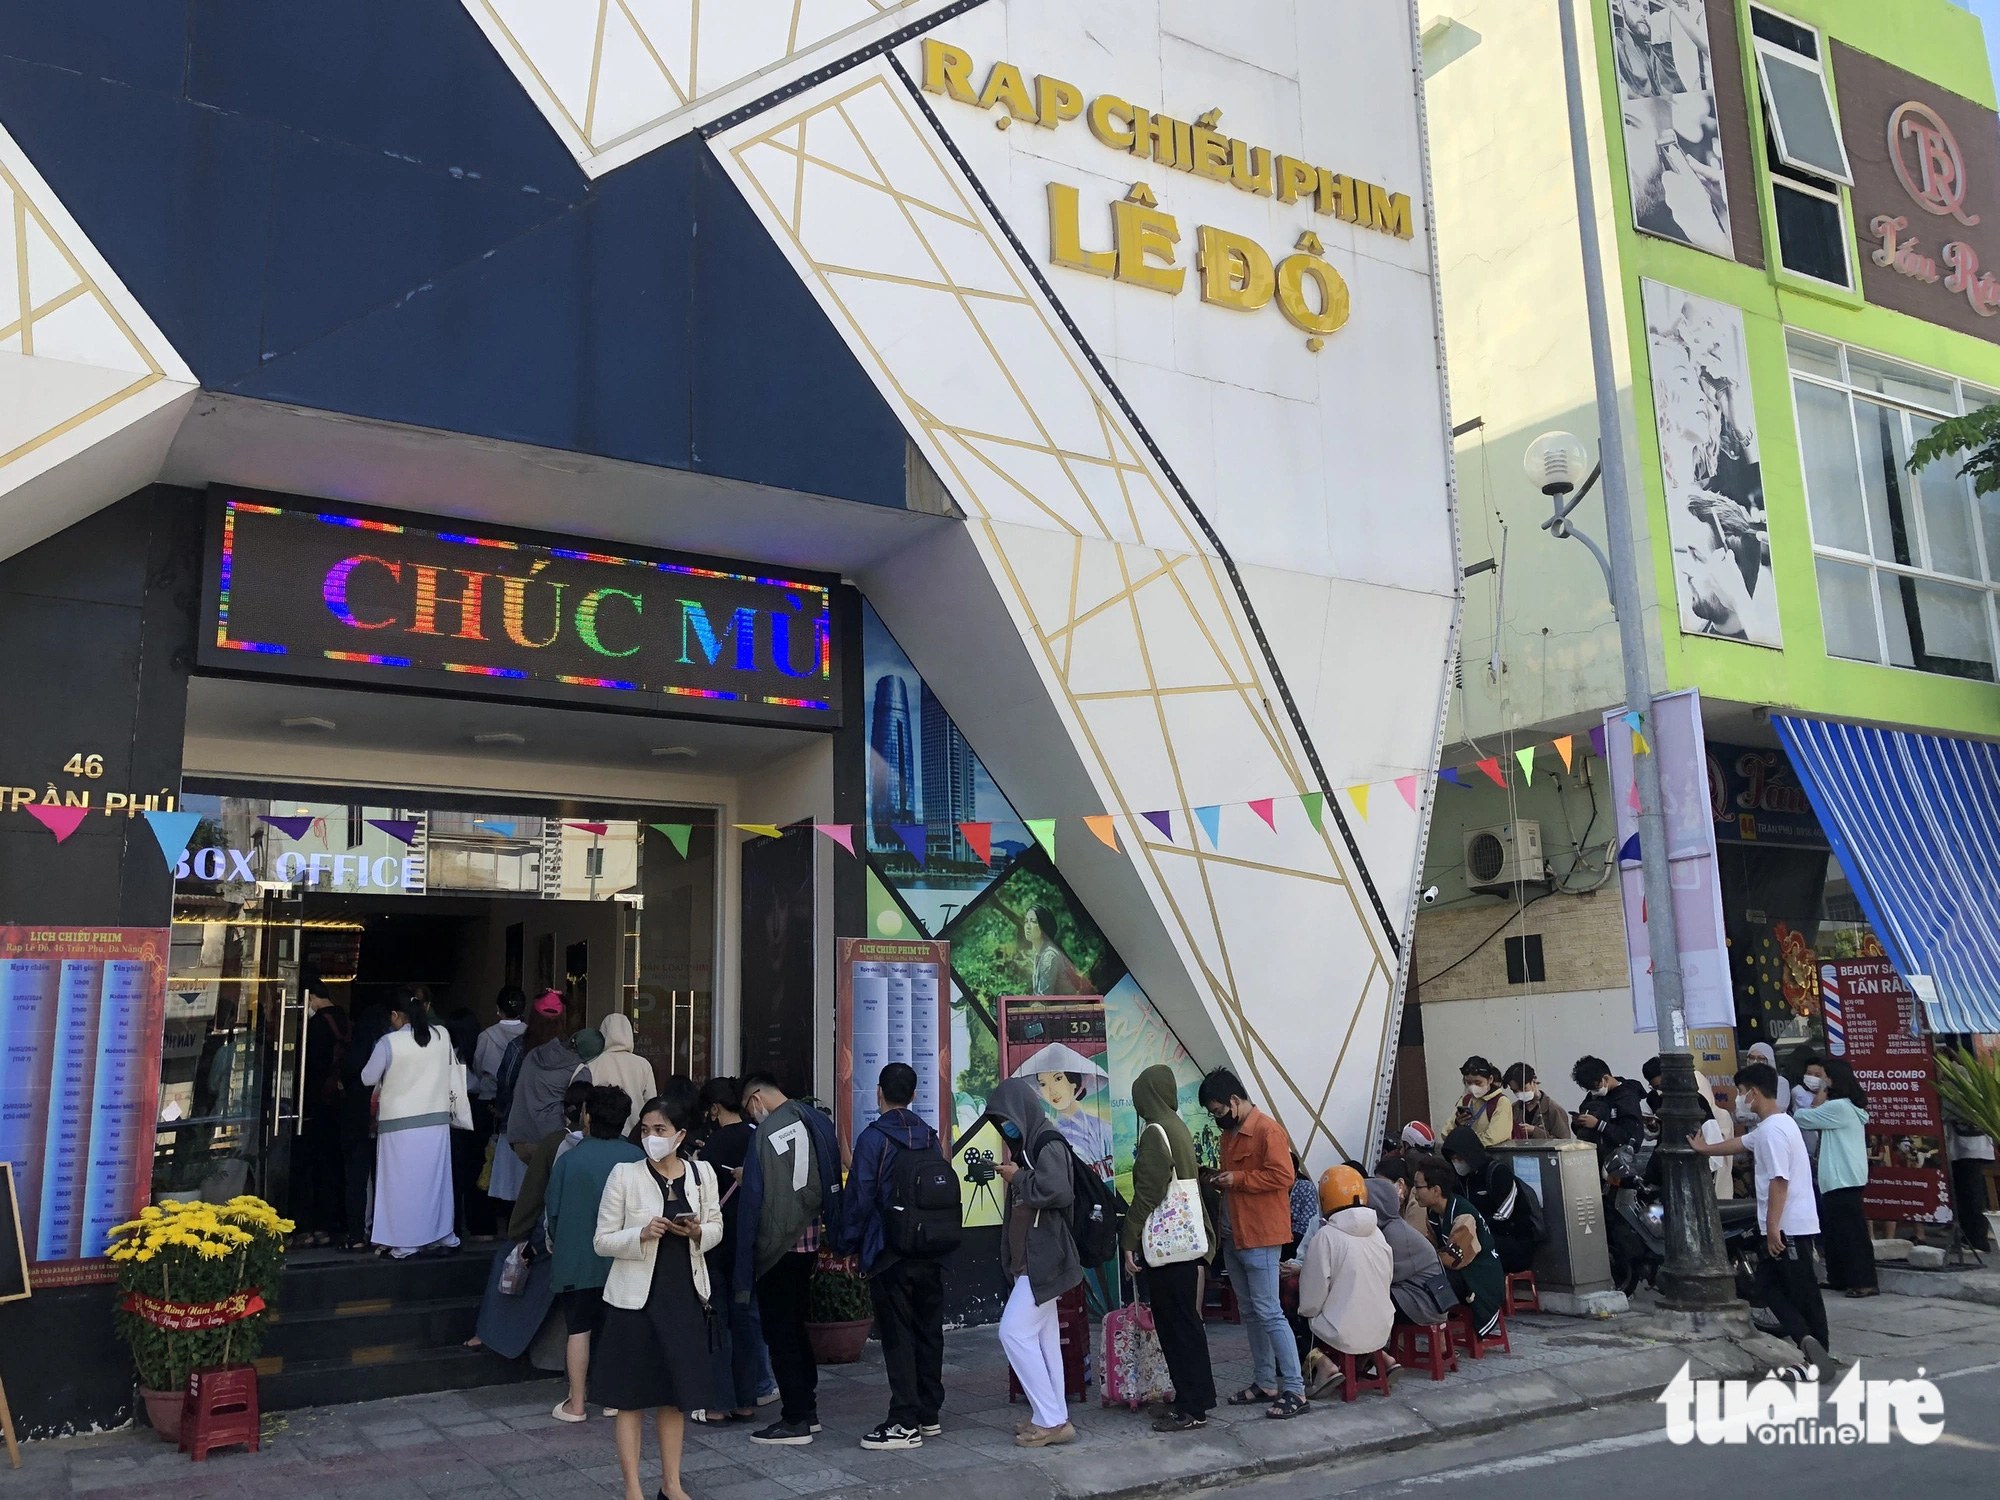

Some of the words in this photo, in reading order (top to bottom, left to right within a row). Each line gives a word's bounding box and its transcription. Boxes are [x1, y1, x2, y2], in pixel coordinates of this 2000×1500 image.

[921, 37, 1084, 131] RẠP
[1087, 95, 1274, 198] CHIẾU
[1275, 154, 1414, 241] PHIM
[1046, 181, 1187, 296] LÊ
[1196, 224, 1351, 353] ĐỘ
[323, 554, 644, 659] CHÚC
[63, 753, 104, 779] 46
[0, 782, 90, 815] TRẦN
[105, 788, 175, 819] PHÚ
[276, 852, 425, 889] OFFICE
[30, 931, 56, 944] LỊCH
[58, 930, 91, 942] CHIẾU
[92, 932, 122, 943] PHIM
[54, 944, 64, 952] 46
[898, 946, 917, 955] PHIM
[1840, 965, 1880, 976] BEAUTY
[1848, 977, 1879, 994] TẤN
[1070, 1021, 1091, 1034] 3D
[1853, 1070, 1885, 1079] KOREA
[1887, 1070, 1926, 1079] COMBO
[767, 1120, 810, 1192] 7
